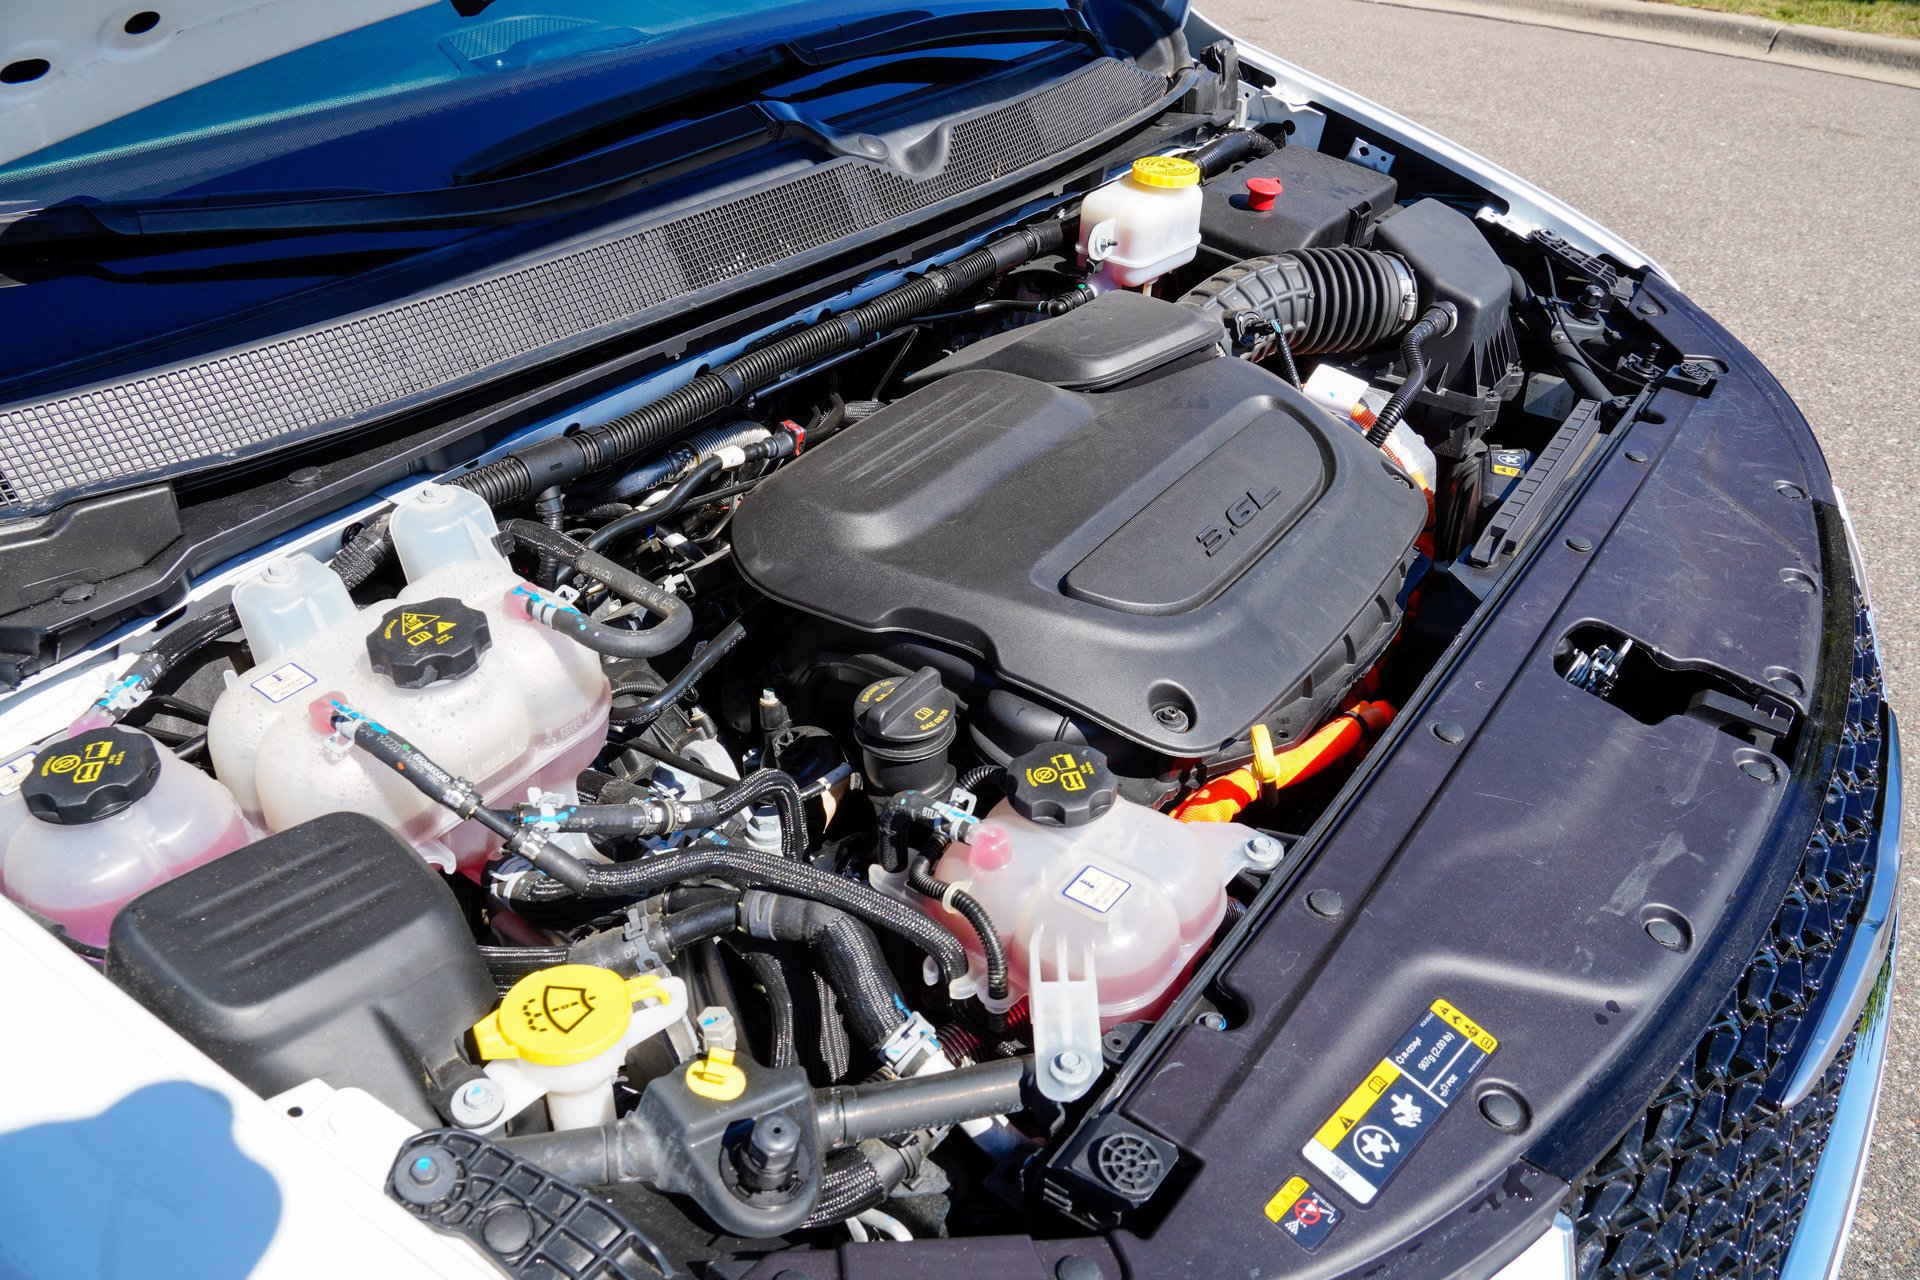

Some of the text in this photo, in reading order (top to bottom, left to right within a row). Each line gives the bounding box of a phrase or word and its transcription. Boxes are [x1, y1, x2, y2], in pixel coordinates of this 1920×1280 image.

[1196, 486, 1281, 557] 3.6L
[861, 685, 881, 702] ENGINE
[920, 709, 949, 731] SAE 0W-20
[1400, 1035, 1422, 1059] R-1234yf
[1416, 1030, 1455, 1071] 907g (2.00 lb)
[1445, 1072, 1458, 1087] POE
